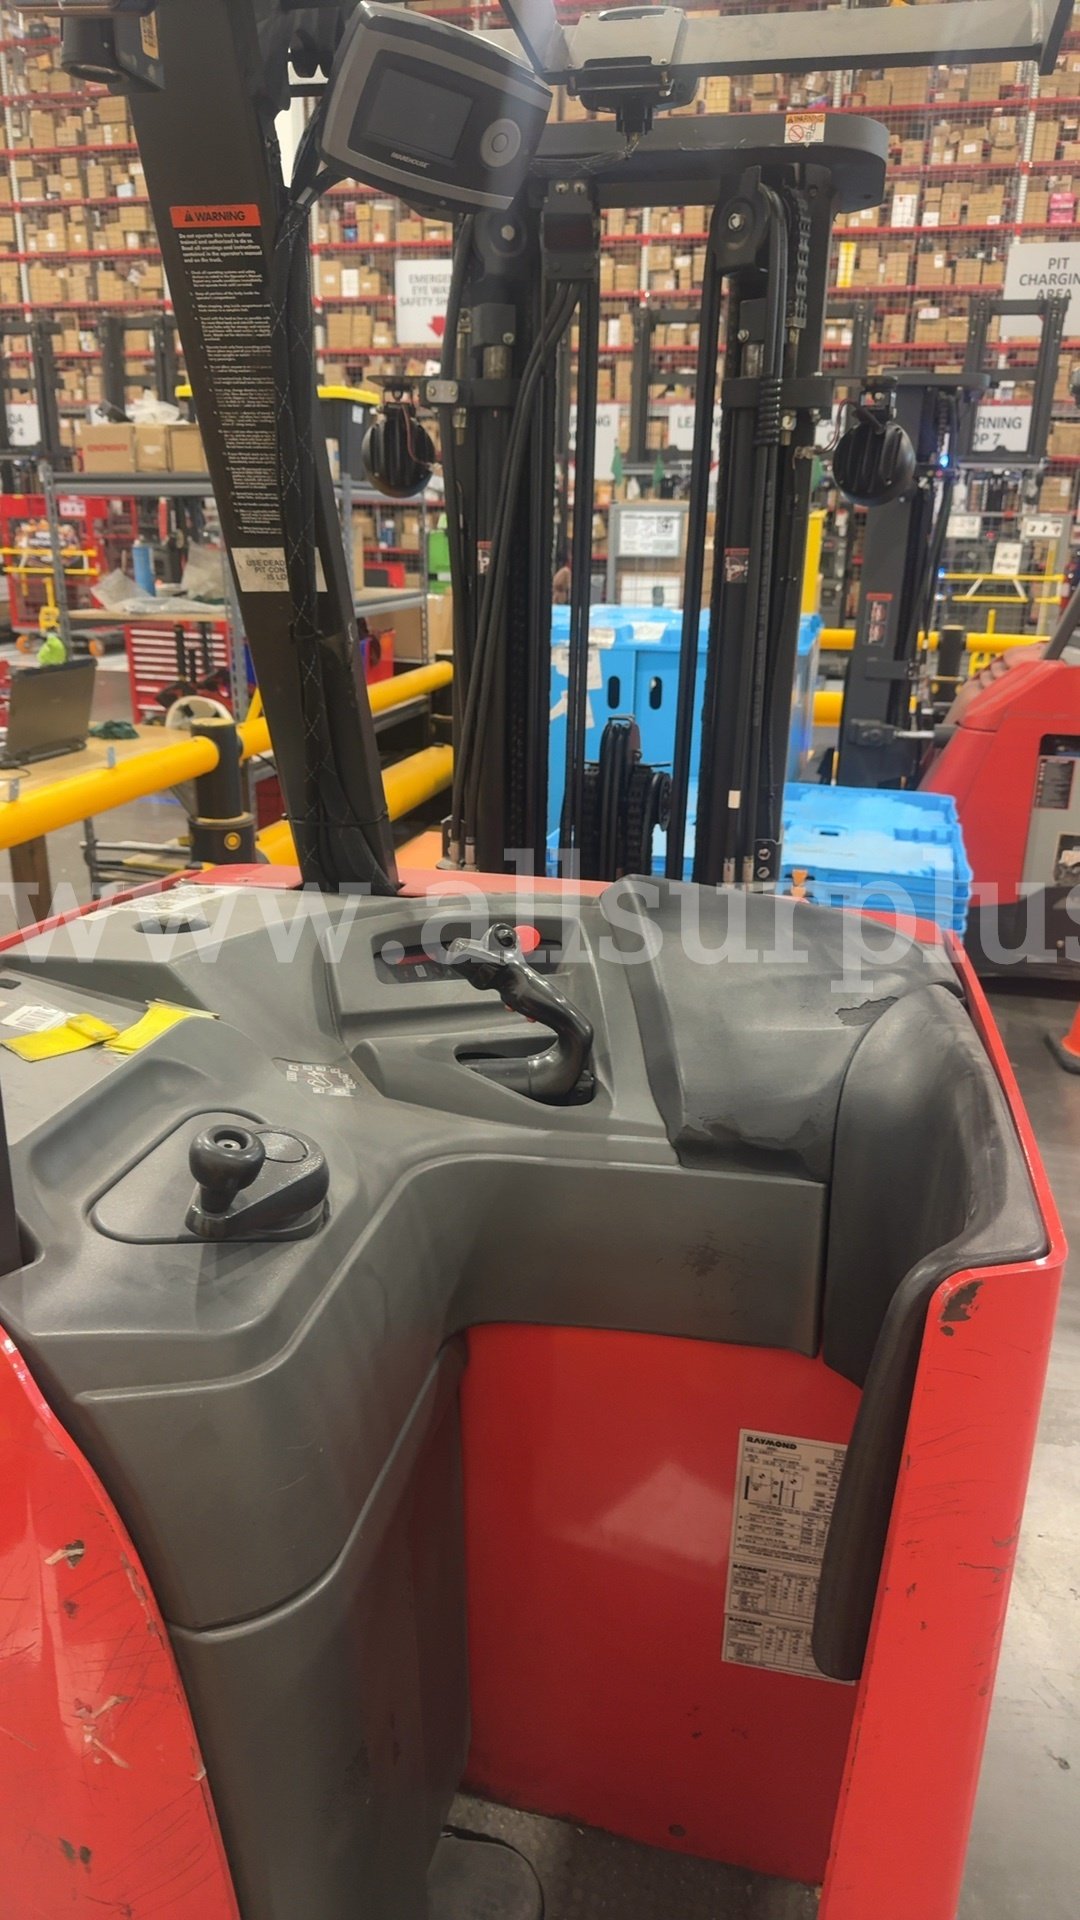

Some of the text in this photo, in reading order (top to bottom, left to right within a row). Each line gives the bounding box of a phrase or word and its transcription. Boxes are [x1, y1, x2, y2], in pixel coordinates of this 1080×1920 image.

[194, 210, 246, 221] WARNING
[1048, 256, 1070, 270] PIT
[408, 274, 452, 284] EMERGE
[1019, 272, 1080, 286] CHARGIN
[412, 286, 449, 295] EYE WA
[1036, 288, 1072, 300] AREA
[400, 296, 433, 306] SAFETY
[993, 433, 1001, 445] 7
[746, 1436, 798, 1450] RAYMOND
